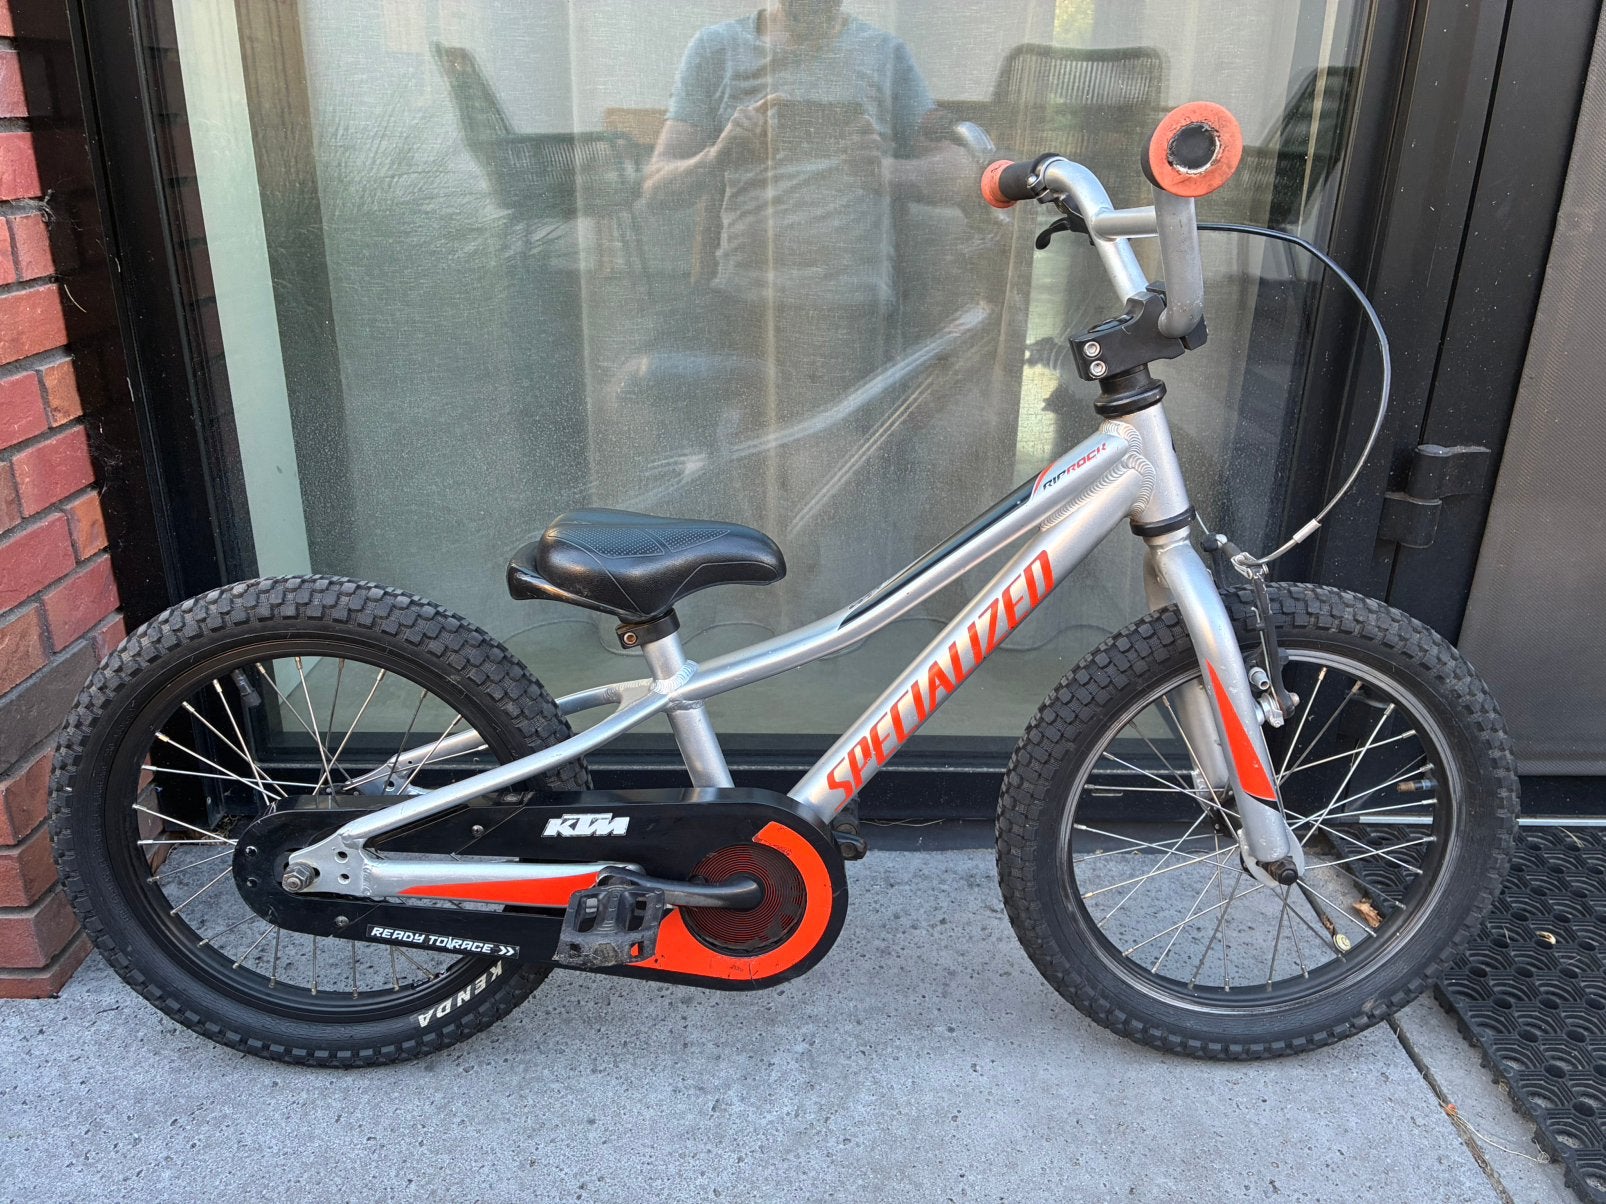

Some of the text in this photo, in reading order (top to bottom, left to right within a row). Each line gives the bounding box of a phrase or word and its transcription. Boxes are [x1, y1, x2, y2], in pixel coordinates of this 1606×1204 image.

[1042, 442, 1107, 491] RIPROCK
[826, 549, 1056, 813] SPECIALIZED
[541, 812, 630, 838] KTM
[370, 926, 494, 954] READY TO RACE
[418, 959, 503, 1028] KENDA
